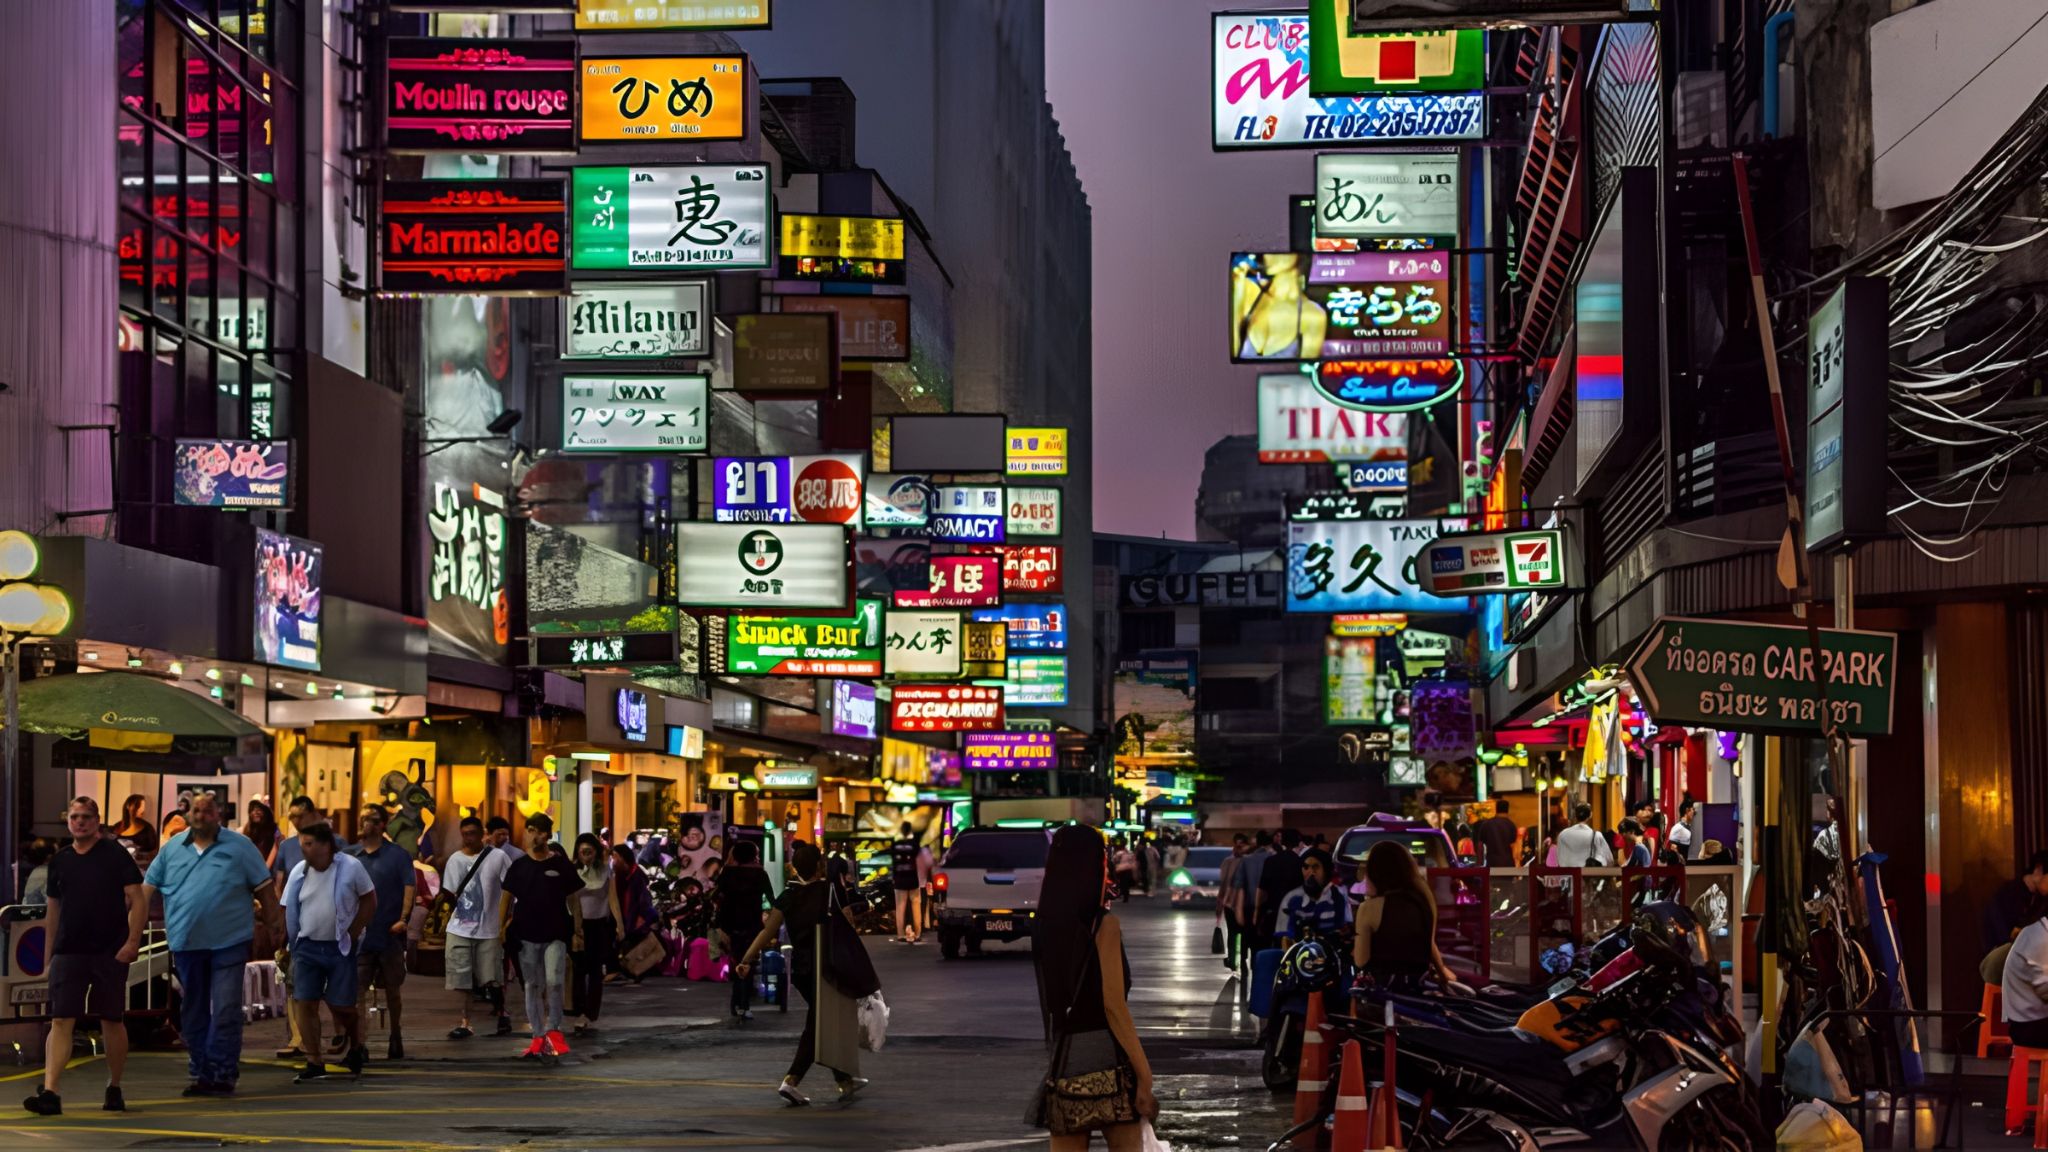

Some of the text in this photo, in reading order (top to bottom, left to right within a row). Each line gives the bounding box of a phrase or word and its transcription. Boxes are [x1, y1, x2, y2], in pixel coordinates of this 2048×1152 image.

[1225, 24, 1305, 51] CLUB
[394, 81, 488, 112] Moulin
[611, 76, 714, 120] ひめ
[389, 222, 560, 255] Marmalade
[1278, 407, 1409, 440] TIAR
[1666, 627, 1757, 677] ที่จอดรถ
[1699, 682, 1769, 717] ธนิยะ
